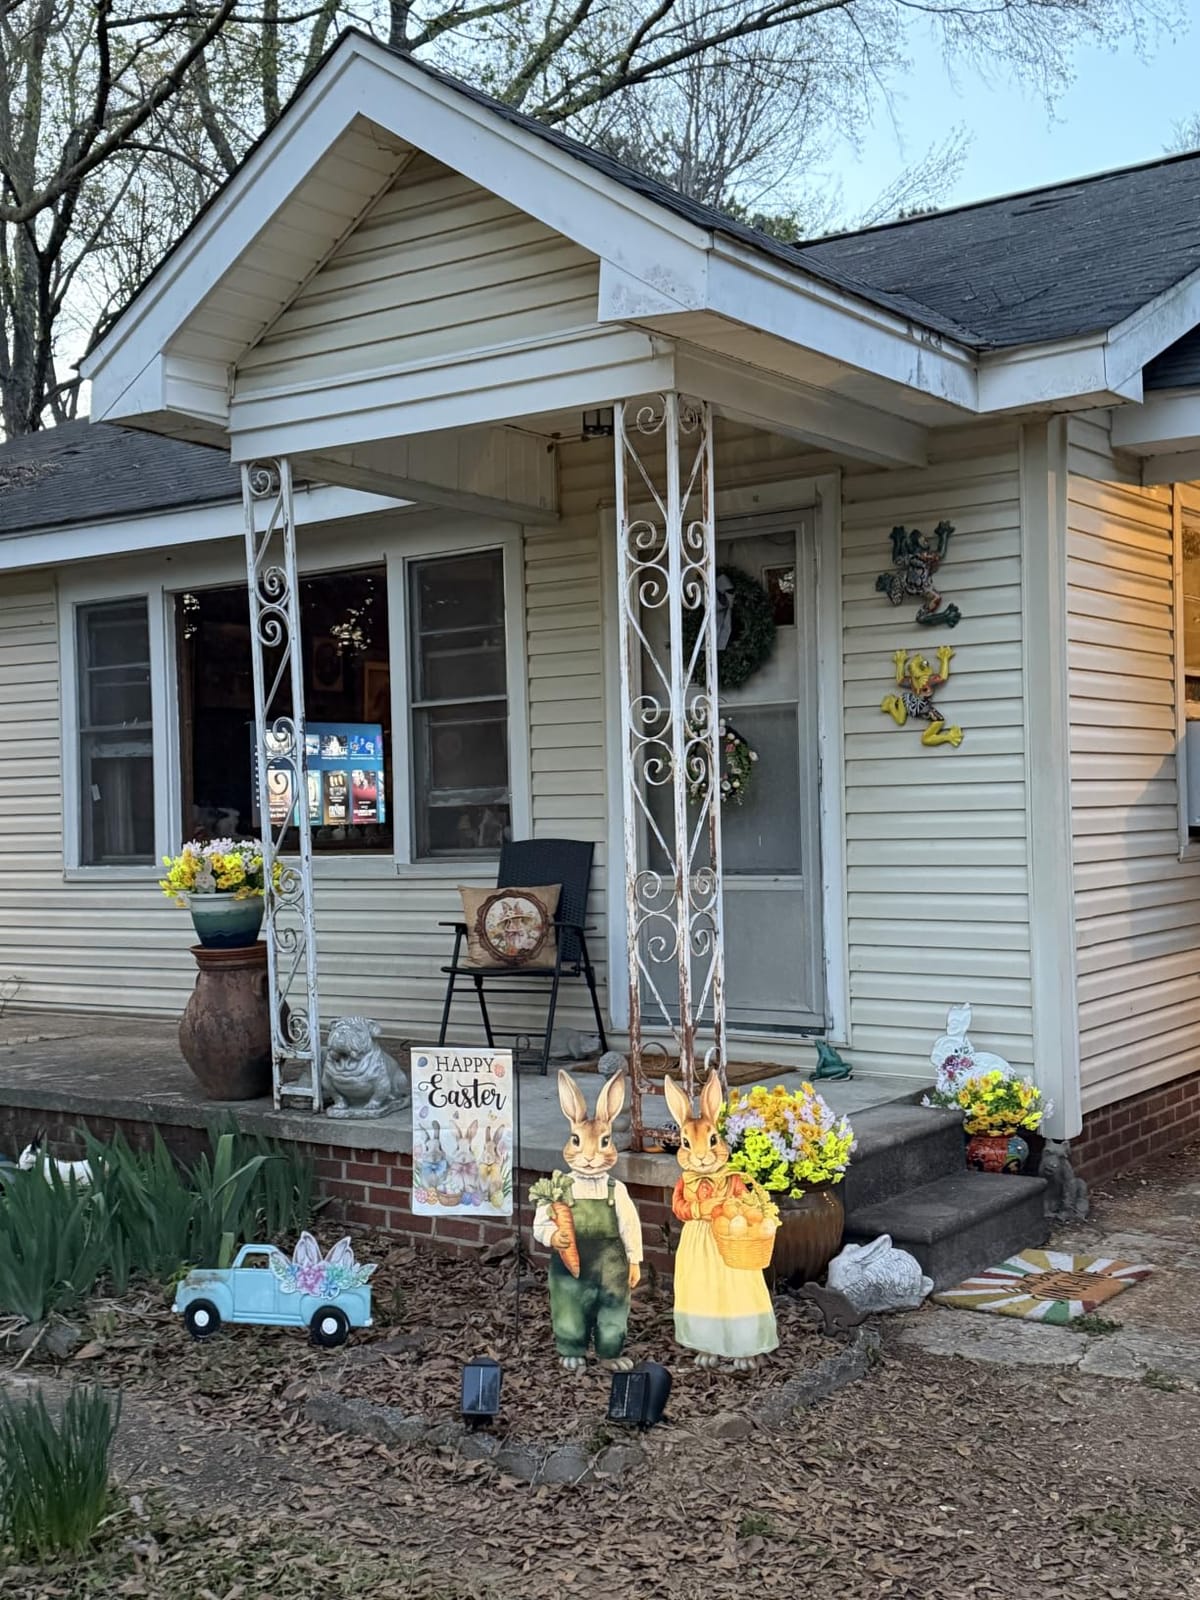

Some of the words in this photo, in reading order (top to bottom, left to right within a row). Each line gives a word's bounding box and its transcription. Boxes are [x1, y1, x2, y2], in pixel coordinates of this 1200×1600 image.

[436, 1056, 494, 1073] HAPPY
[418, 1073, 507, 1111] Easter
[1031, 1267, 1112, 1304] SUNSHINE
